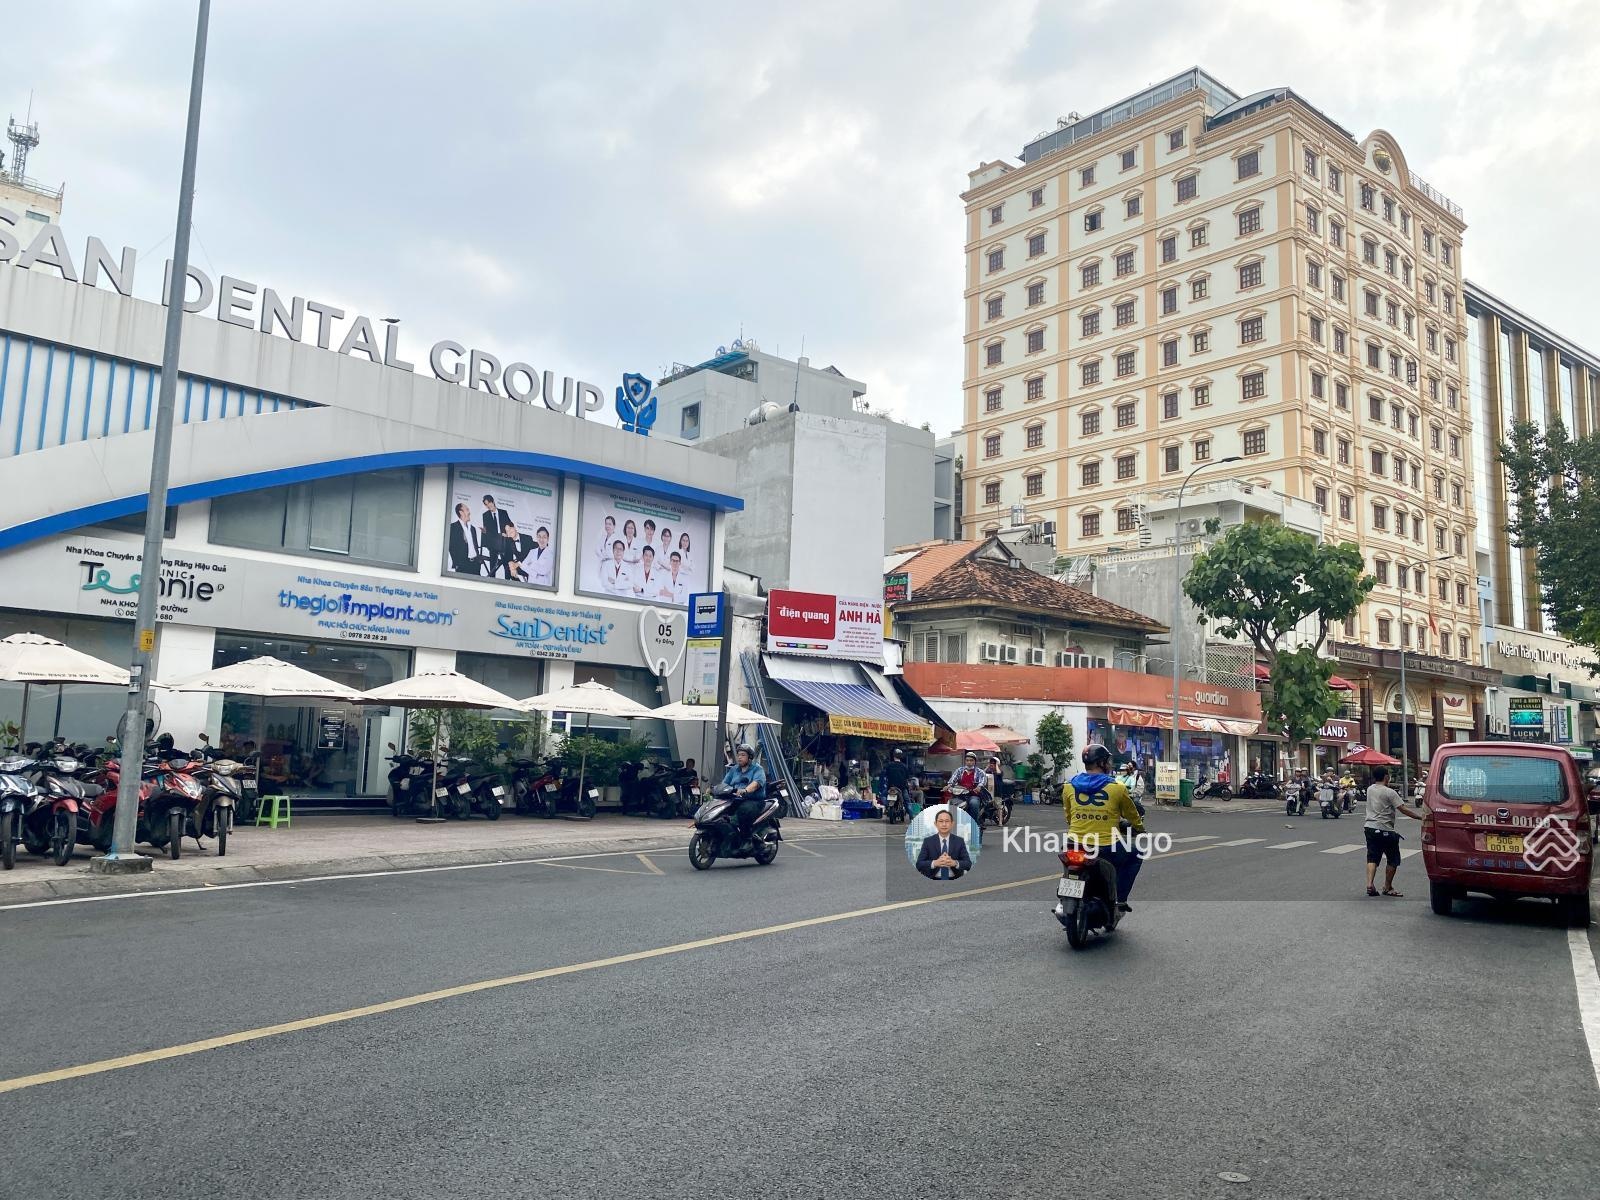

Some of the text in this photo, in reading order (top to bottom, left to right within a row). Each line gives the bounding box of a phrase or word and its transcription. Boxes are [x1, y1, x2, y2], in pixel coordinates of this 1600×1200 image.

[161, 258, 414, 373] DENTAL
[430, 340, 605, 419] GROUP
[65, 546, 82, 554] Nha
[83, 548, 104, 557] Khoa
[106, 551, 135, 561] Chuyên
[175, 560, 193, 569] Răng
[195, 562, 211, 571] Hiệu
[212, 564, 227, 572] Quả
[297, 575, 311, 584] Nha
[313, 577, 331, 587] Khoa
[100, 598, 117, 606] NHA
[160, 604, 188, 614] ĐƯỜNG
[160, 613, 173, 621] 680
[777, 606, 830, 624] điện quang
[839, 610, 881, 624] ANH HÀ
[489, 613, 608, 645] SanDentist
[658, 624, 672, 637] 05
[1498, 640, 1519, 657] Ngân
[1520, 643, 1538, 662] hàng
[1539, 648, 1560, 663] TMCP
[1195, 690, 1229, 706] guardian
[1513, 730, 1540, 738] LUCKY
[1474, 813, 1497, 825] 50G
[1496, 837, 1513, 845] 50G
[1467, 857, 1540, 870] KENB
